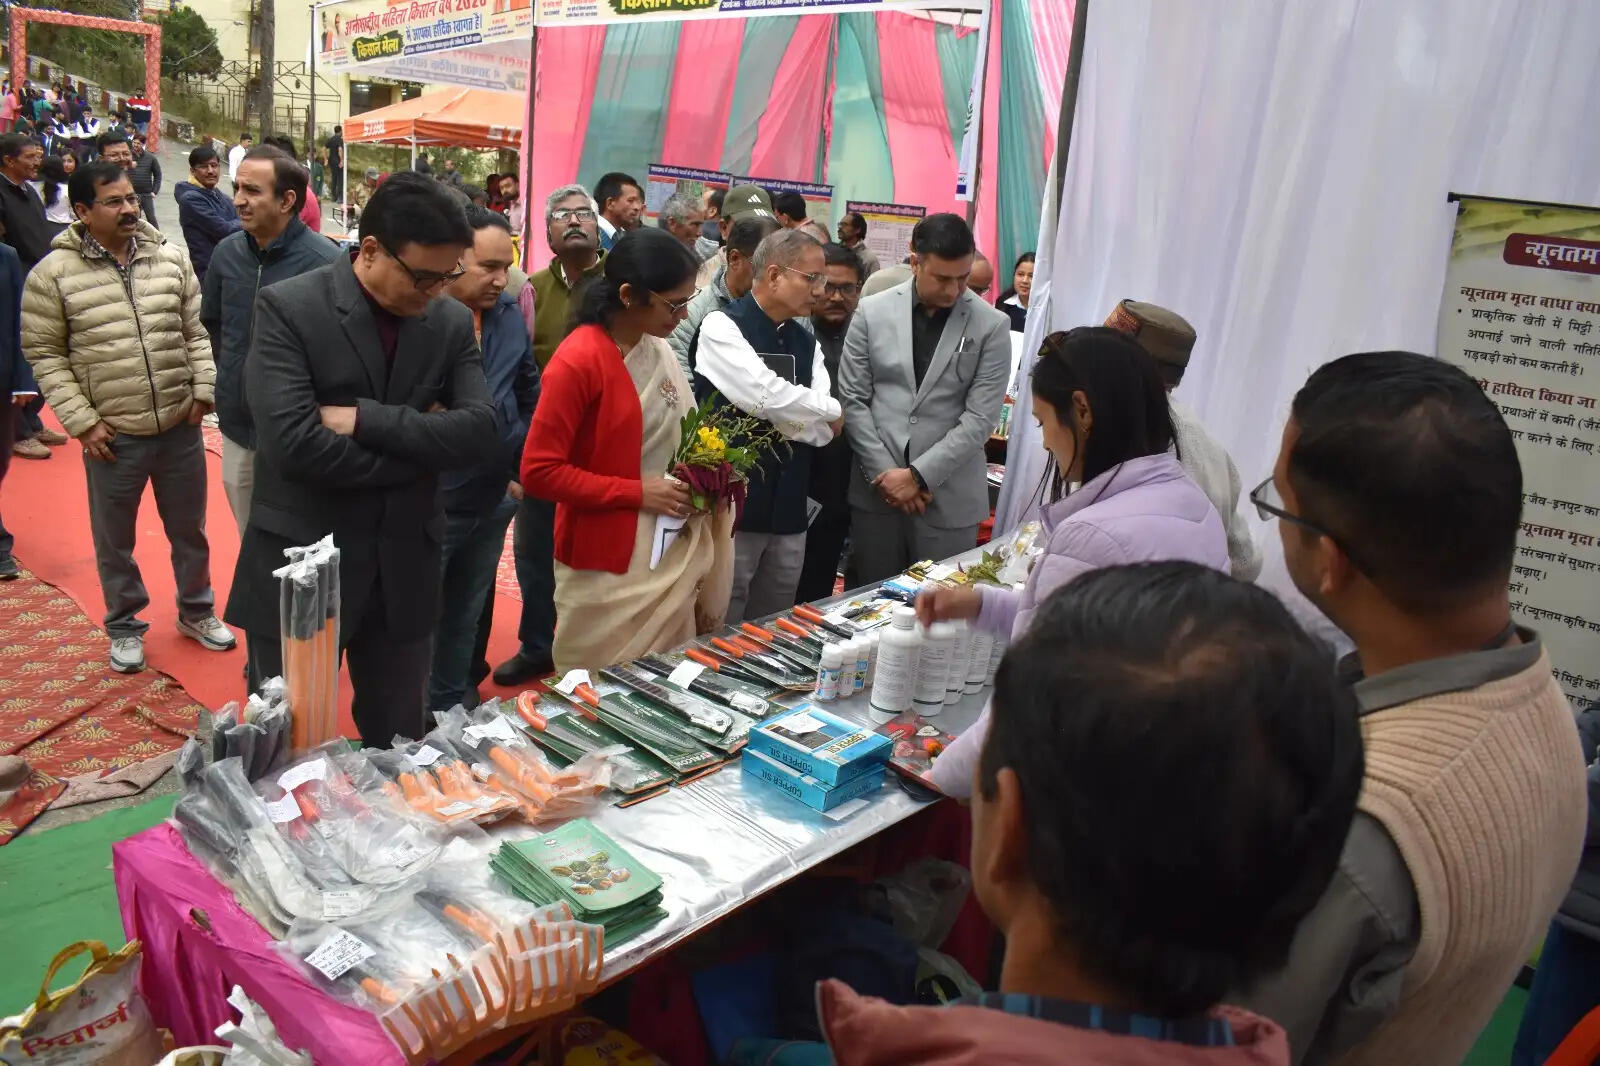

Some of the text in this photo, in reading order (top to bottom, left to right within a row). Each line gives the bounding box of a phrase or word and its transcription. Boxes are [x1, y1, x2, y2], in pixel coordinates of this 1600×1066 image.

[356, 40, 381, 58] किसान
[381, 35, 399, 54] मेला
[1525, 241, 1597, 266] न्यूनतम
[1460, 286, 1508, 302] न्यूनतम
[1511, 292, 1537, 307] मृदा
[1540, 296, 1574, 311] बाधा
[1471, 308, 1593, 336] प्राकृतिक खेती में मिट्टी
[1467, 328, 1503, 343] अपनाई
[1510, 333, 1532, 347] जाने
[1538, 338, 1567, 352] वाली
[1463, 349, 1501, 365] गड़बड़ी
[1502, 353, 1517, 366] को
[1519, 357, 1539, 369] कम
[1540, 360, 1570, 374] करती
[1492, 382, 1536, 400] हासिल
[1538, 388, 1575, 406] किया
[1577, 396, 1598, 409] जा
[1501, 405, 1538, 420] प्रथाओं
[1539, 410, 1549, 422] में
[1551, 414, 1576, 427] कमी
[1527, 432, 1552, 446] करने
[1556, 436, 1568, 449] के
[1571, 438, 1594, 456] लिए
[1519, 522, 1595, 547] न्यूनतम मृदा
[1520, 546, 1597, 571] संरचना में सुधार
[1563, 615, 1587, 629] कृषि
[1561, 671, 1584, 688] मिट्टी
[770, 746, 813, 774] COPPER SIL
[761, 769, 802, 798] COPPER SIL
